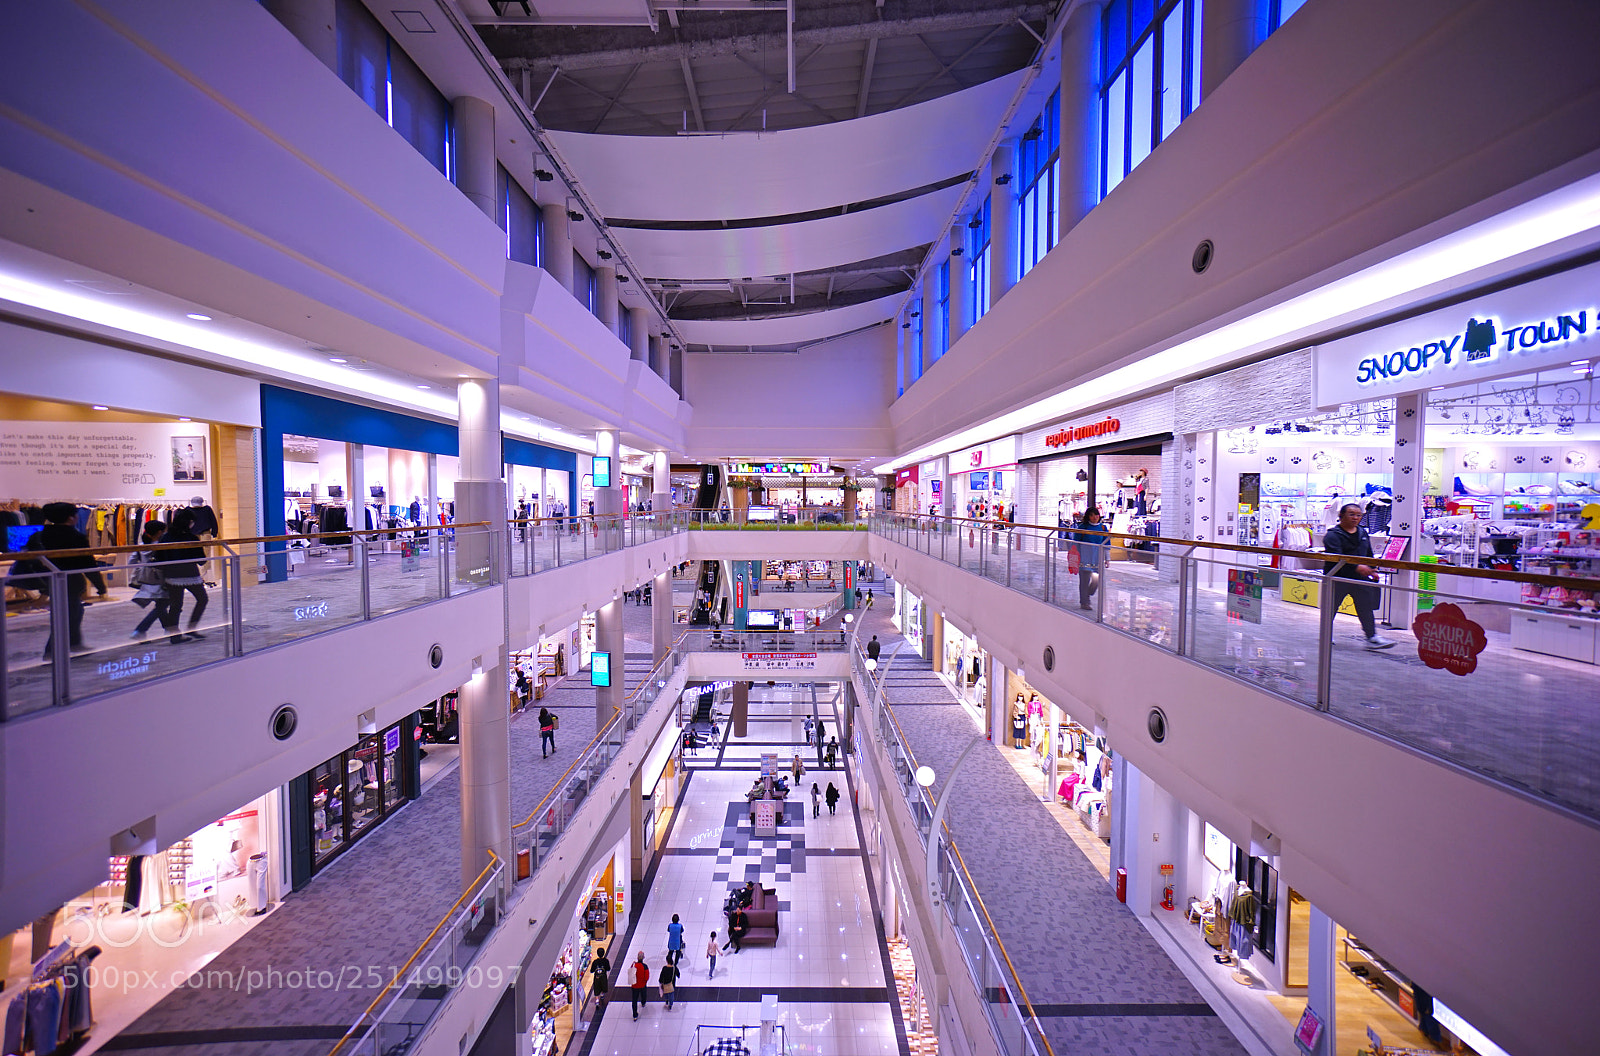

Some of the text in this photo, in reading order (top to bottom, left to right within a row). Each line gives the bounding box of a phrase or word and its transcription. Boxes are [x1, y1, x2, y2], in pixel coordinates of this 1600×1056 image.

[1357, 335, 1461, 383] SNOOPY
[1502, 311, 1587, 352] TOWN
[83, 434, 137, 442] unforgettable.
[1045, 416, 1121, 448] repipi armario
[91, 443, 119, 451] special
[122, 452, 157, 460] properly.
[122, 477, 140, 485] CLIP
[1422, 621, 1474, 647] SAKURA
[1422, 636, 1474, 662] FESTIVAL
